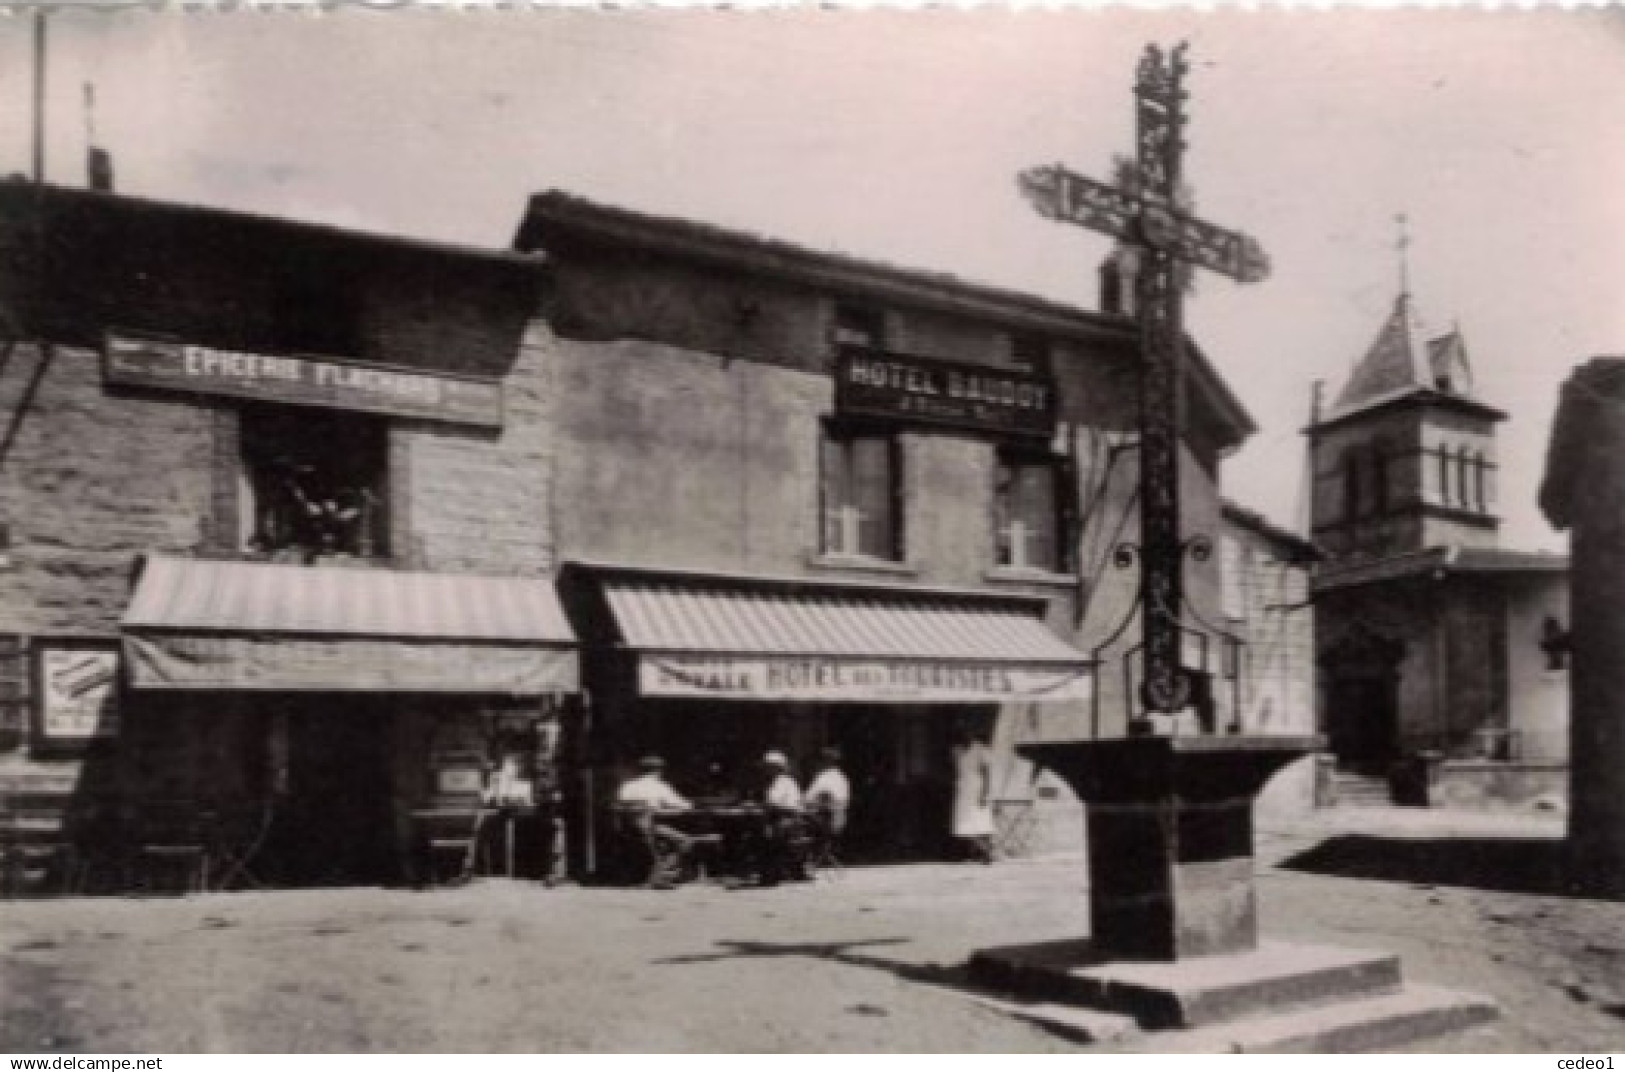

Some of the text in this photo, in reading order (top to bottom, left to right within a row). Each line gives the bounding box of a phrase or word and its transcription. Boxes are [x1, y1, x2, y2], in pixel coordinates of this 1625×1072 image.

[183, 345, 301, 379] EPICERIE
[851, 357, 941, 395] HOTEL
[766, 659, 844, 691] HOTEL
